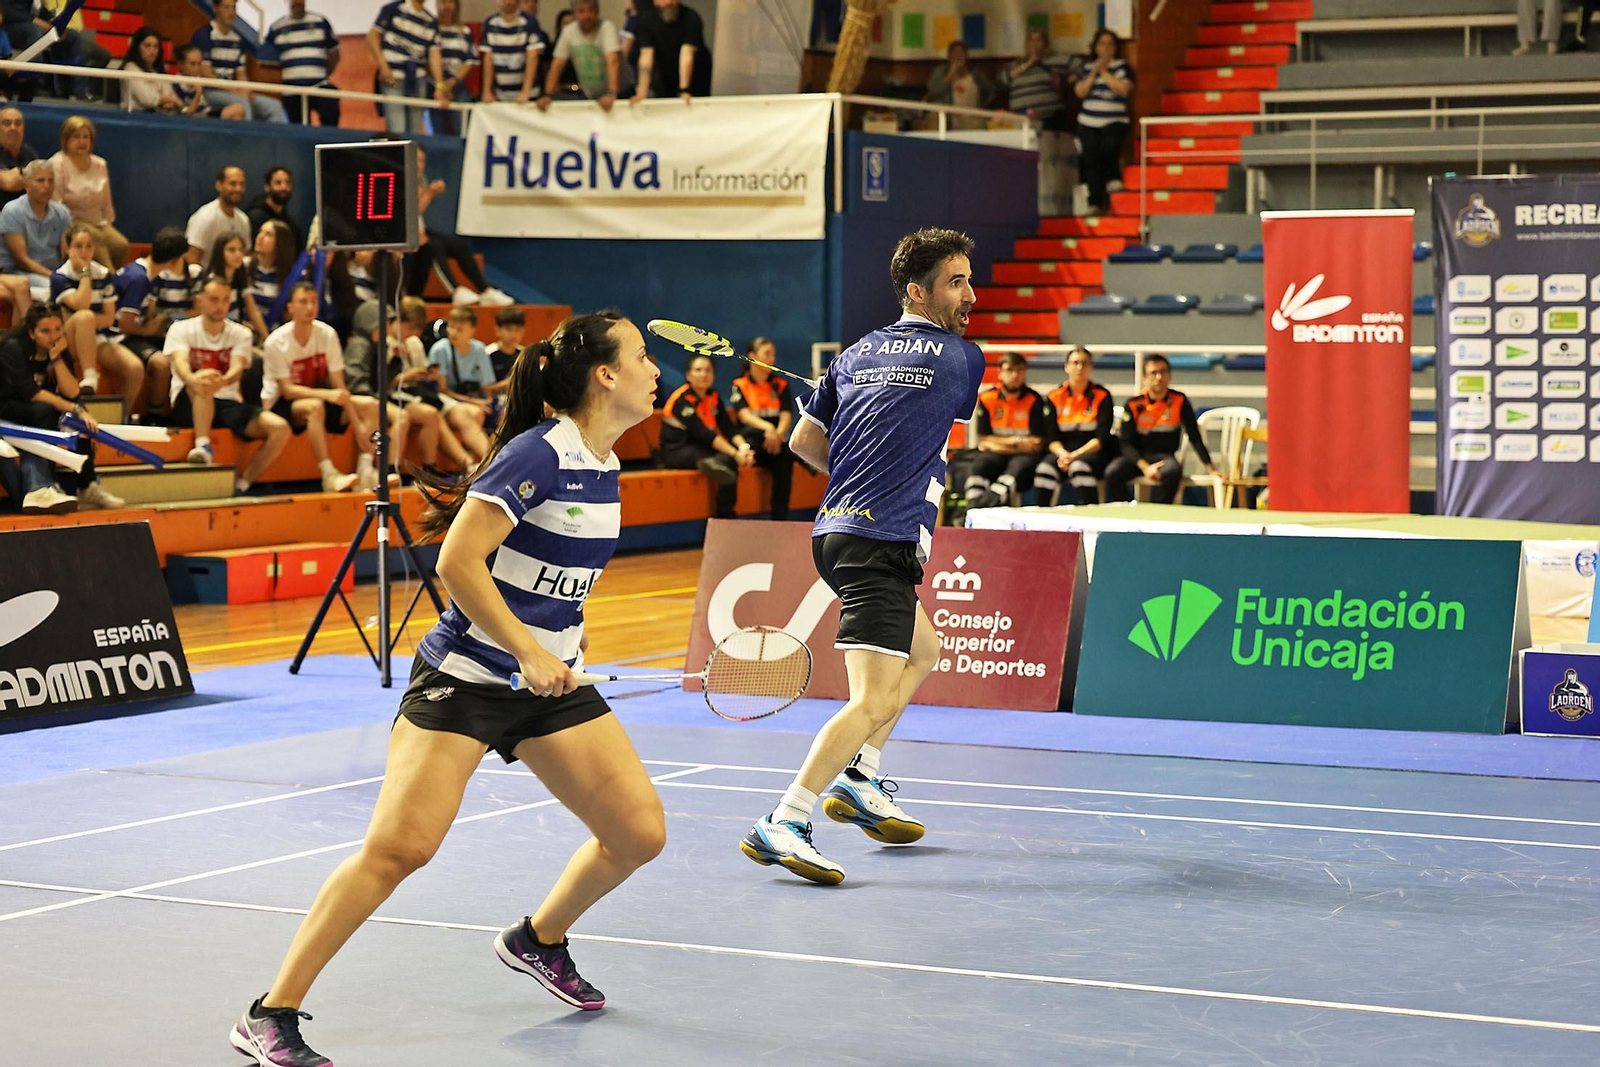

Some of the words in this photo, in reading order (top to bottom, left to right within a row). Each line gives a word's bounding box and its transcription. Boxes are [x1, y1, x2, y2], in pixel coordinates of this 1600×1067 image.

[483, 132, 661, 190] Huelva
[672, 167, 807, 191] Información
[356, 173, 395, 220] 10
[1515, 203, 1600, 226] RECRE
[1292, 324, 1404, 343] BADMINTON
[857, 342, 872, 357] P.
[869, 373, 883, 382] LA
[887, 372, 933, 386] ORDEN
[532, 565, 597, 599] Huel
[933, 608, 1012, 634] Consejo
[1235, 587, 1466, 631] Fundación
[93, 618, 170, 647] ESPAÑA
[956, 654, 1046, 679] Deportes
[1231, 628, 1395, 681] Unicaja
